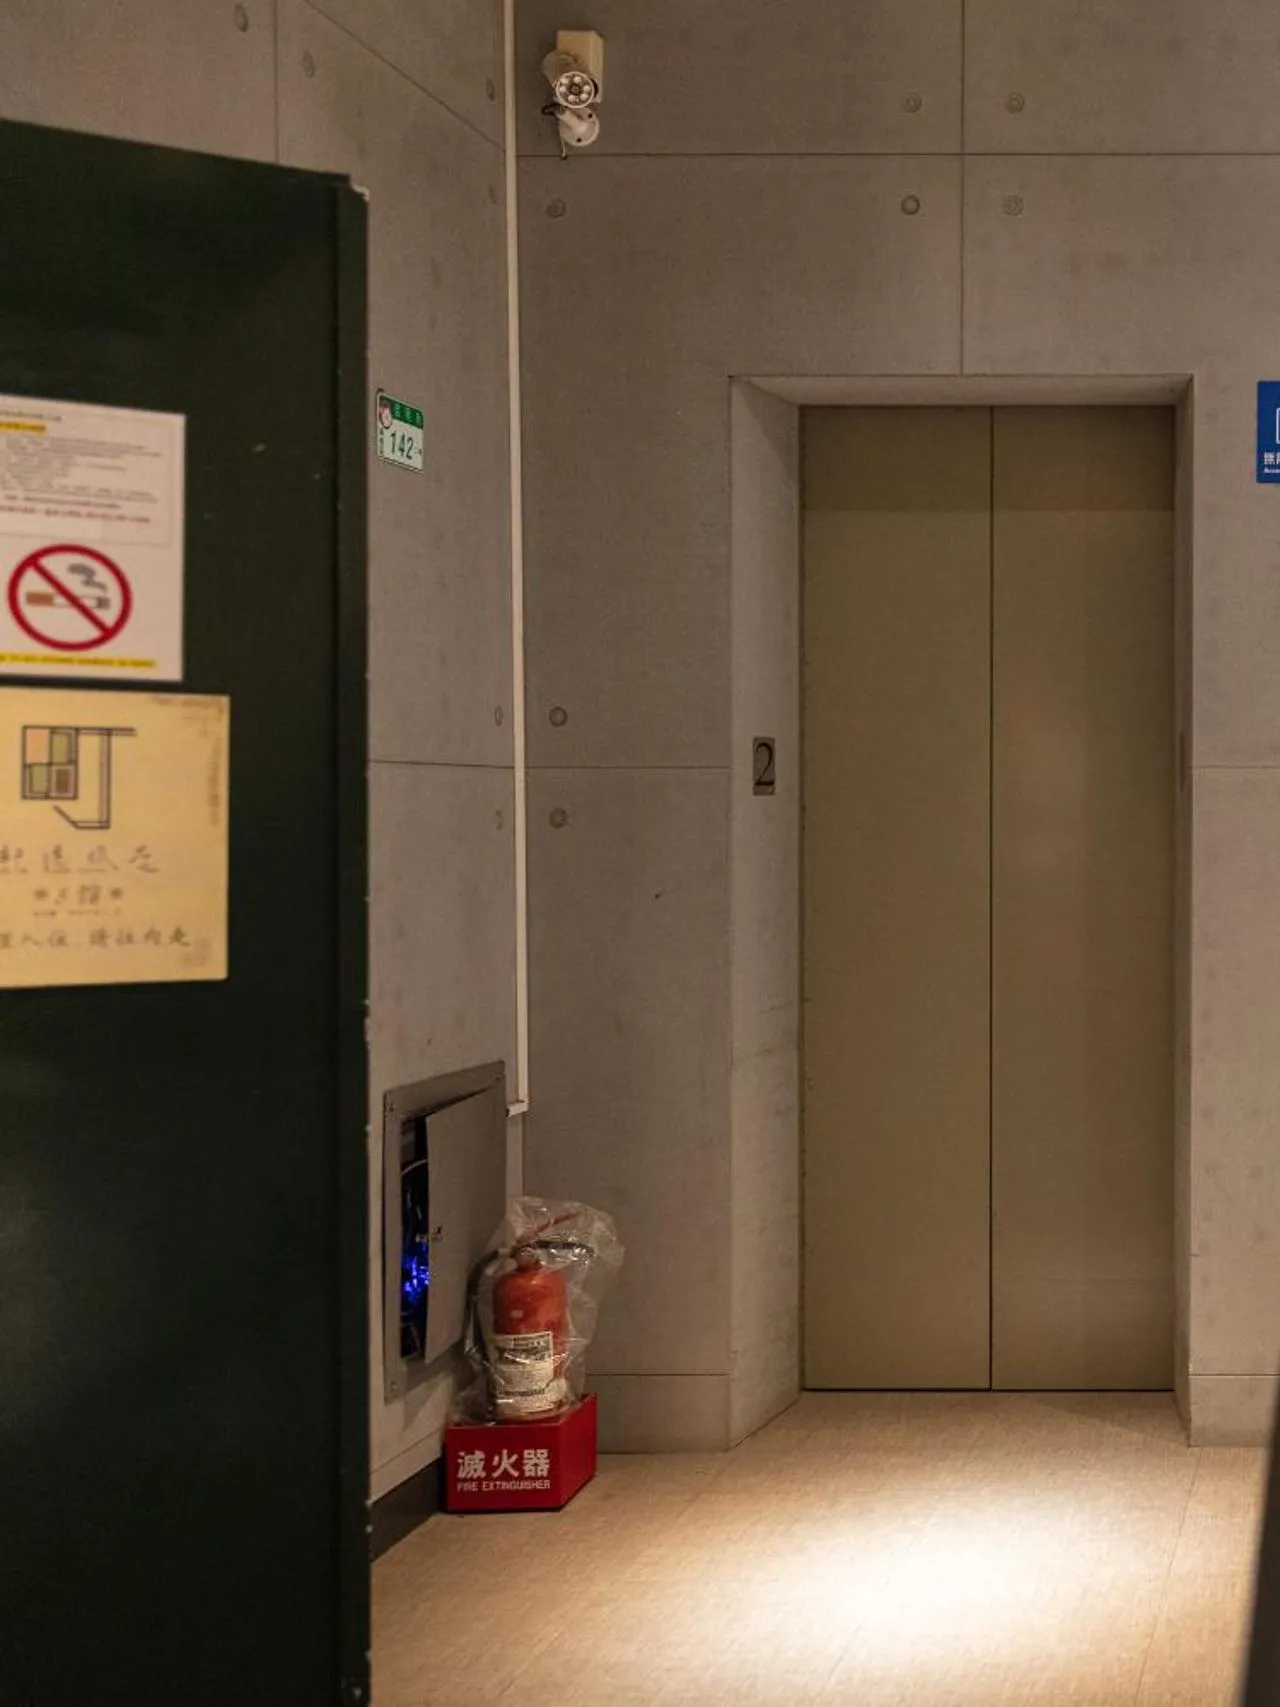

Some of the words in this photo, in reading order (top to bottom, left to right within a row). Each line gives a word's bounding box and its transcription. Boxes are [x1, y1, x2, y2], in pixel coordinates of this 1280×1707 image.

[755, 742, 775, 787] 2
[457, 1448, 550, 1479] 滅火器
